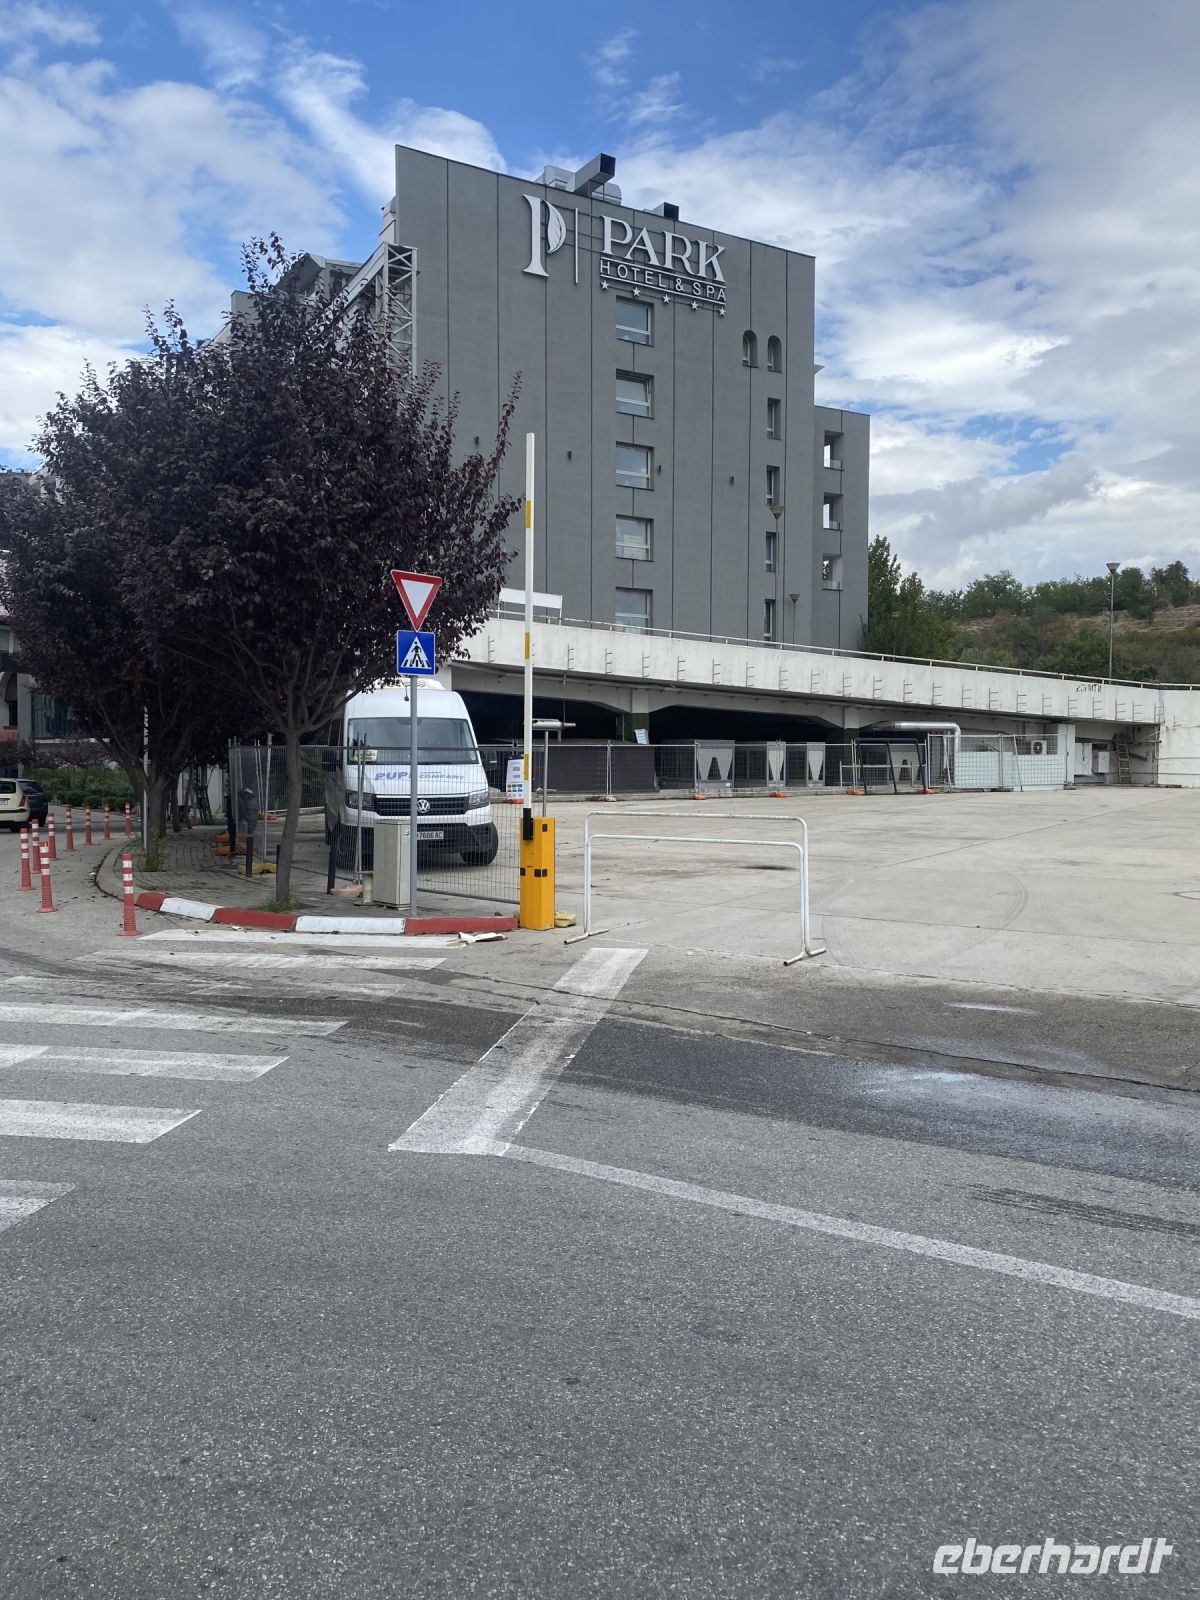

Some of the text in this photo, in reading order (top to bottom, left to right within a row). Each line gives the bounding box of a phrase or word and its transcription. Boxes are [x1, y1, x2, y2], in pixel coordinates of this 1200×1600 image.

[600, 214, 726, 282] PARK
[600, 259, 726, 302] HOTEL & SPA
